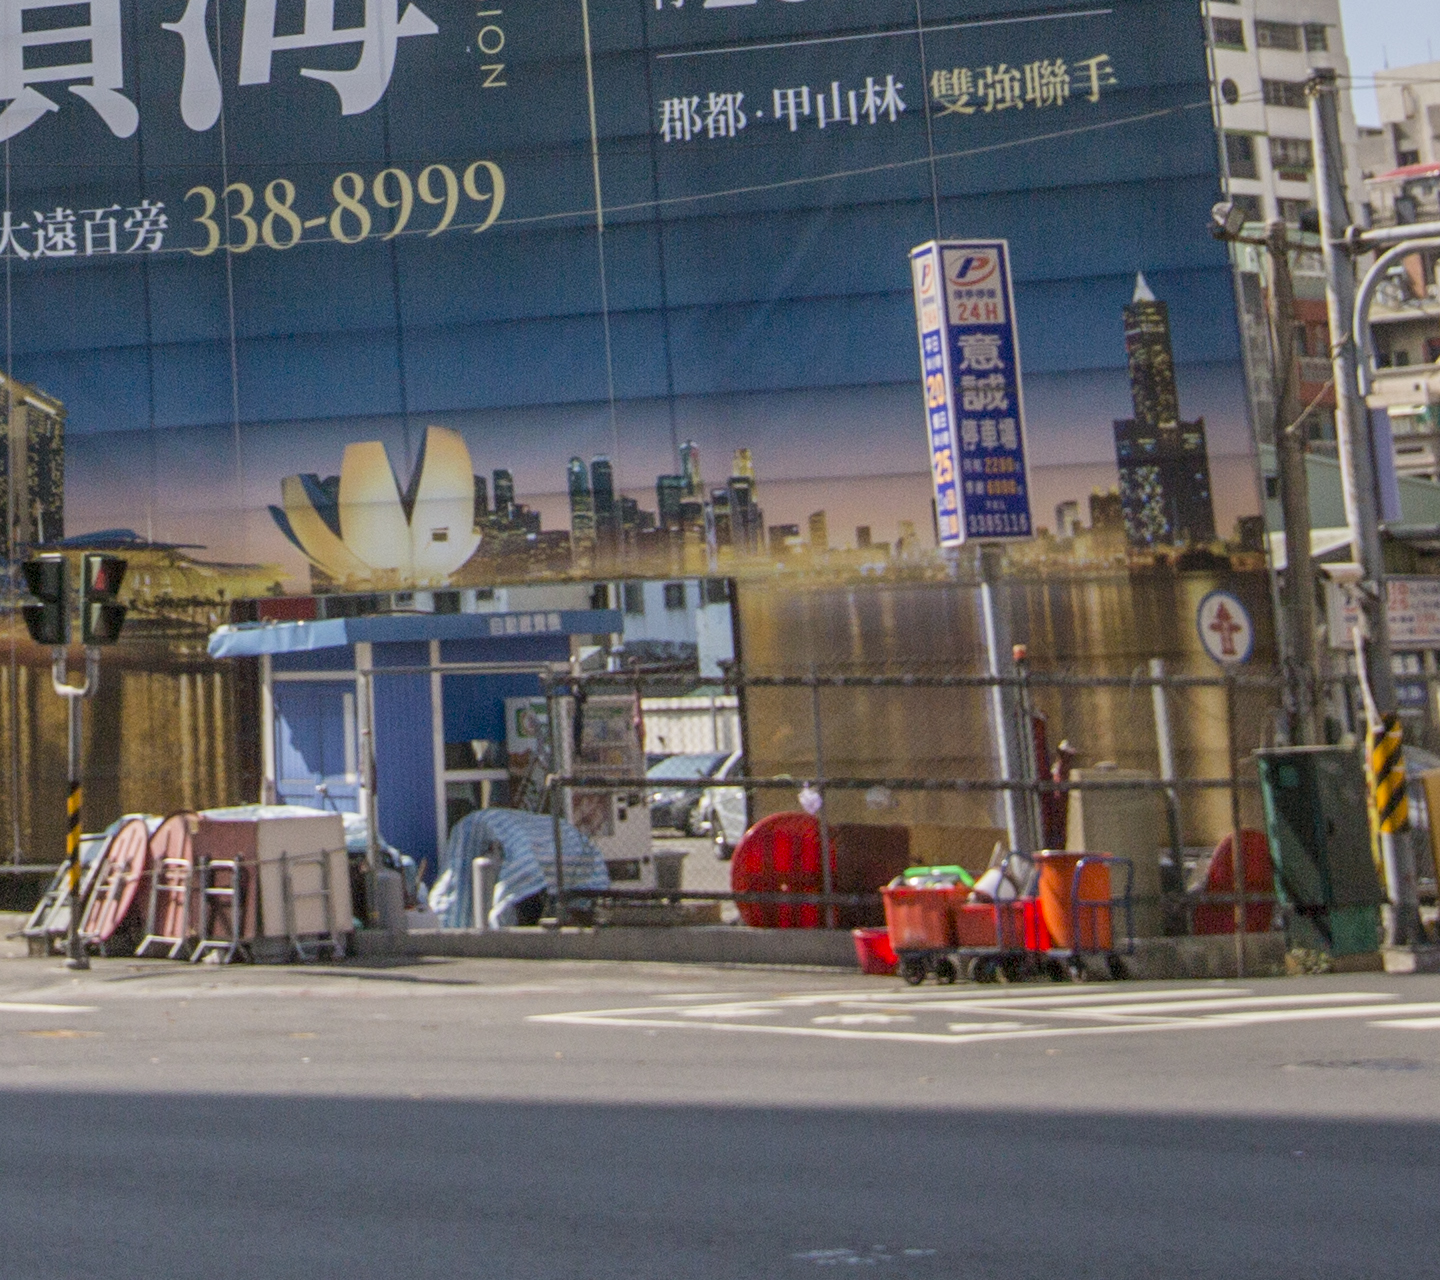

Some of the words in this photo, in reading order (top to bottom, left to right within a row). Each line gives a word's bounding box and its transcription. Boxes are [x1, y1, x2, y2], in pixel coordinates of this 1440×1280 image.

[929, 53, 1117, 119] 雙強聯手
[184, 159, 507, 257] 338-8999
[957, 333, 1010, 412] 意誠
[961, 417, 1018, 451] 停車場
